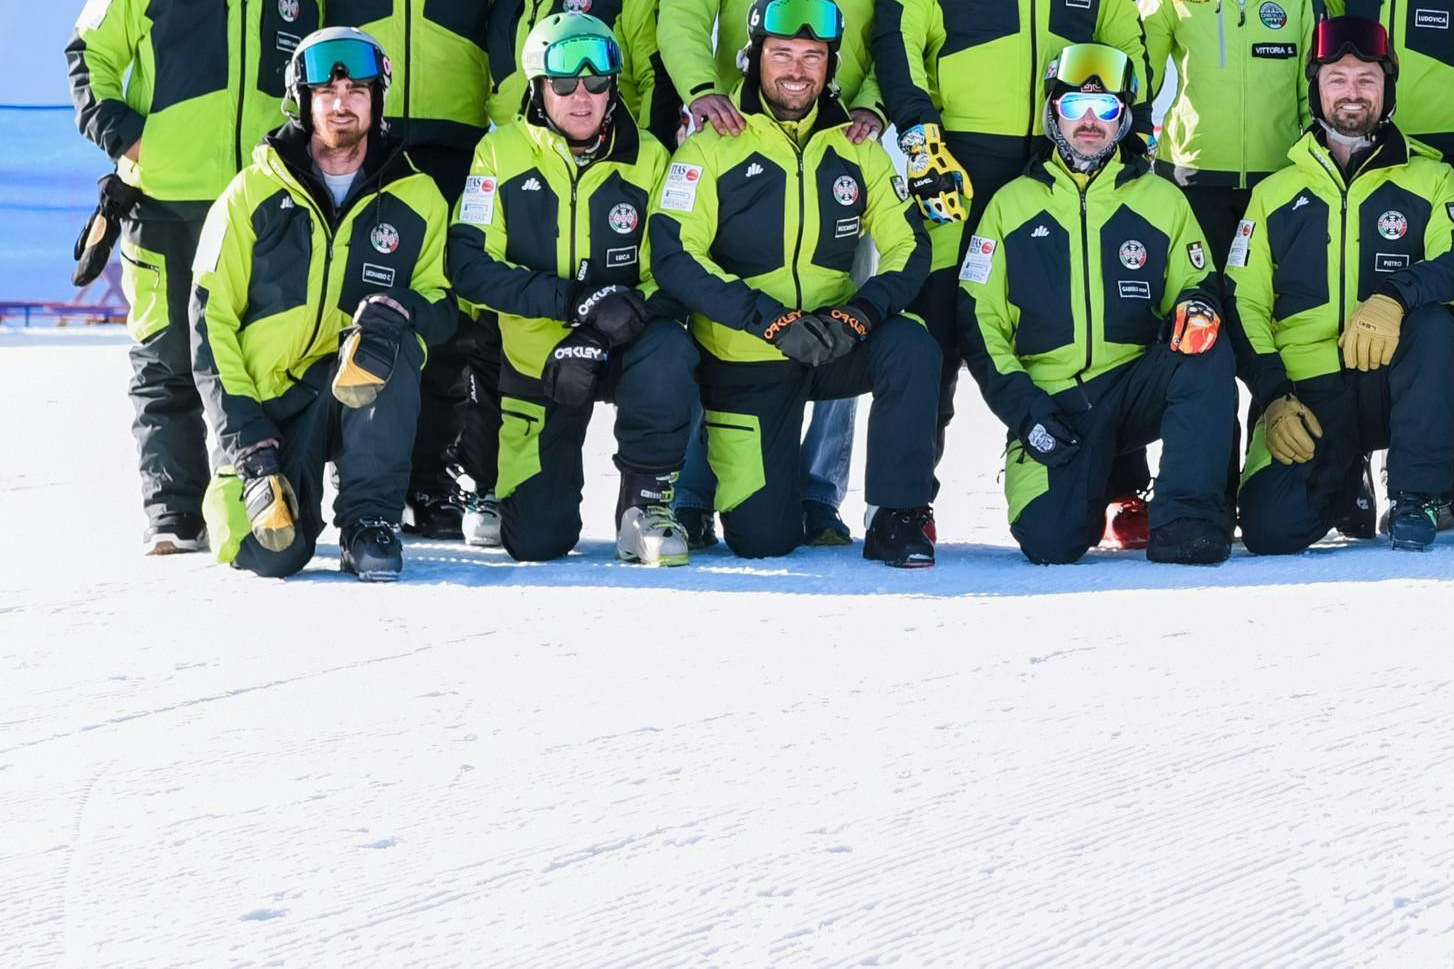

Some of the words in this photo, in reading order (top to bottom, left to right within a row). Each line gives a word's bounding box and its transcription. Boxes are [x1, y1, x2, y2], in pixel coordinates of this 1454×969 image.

[914, 178, 933, 188] LEVEL
[615, 253, 630, 262] LUCA
[578, 284, 617, 315] OAKLEY
[764, 309, 802, 340] OAKLEY
[554, 346, 602, 360] OAKLEY
